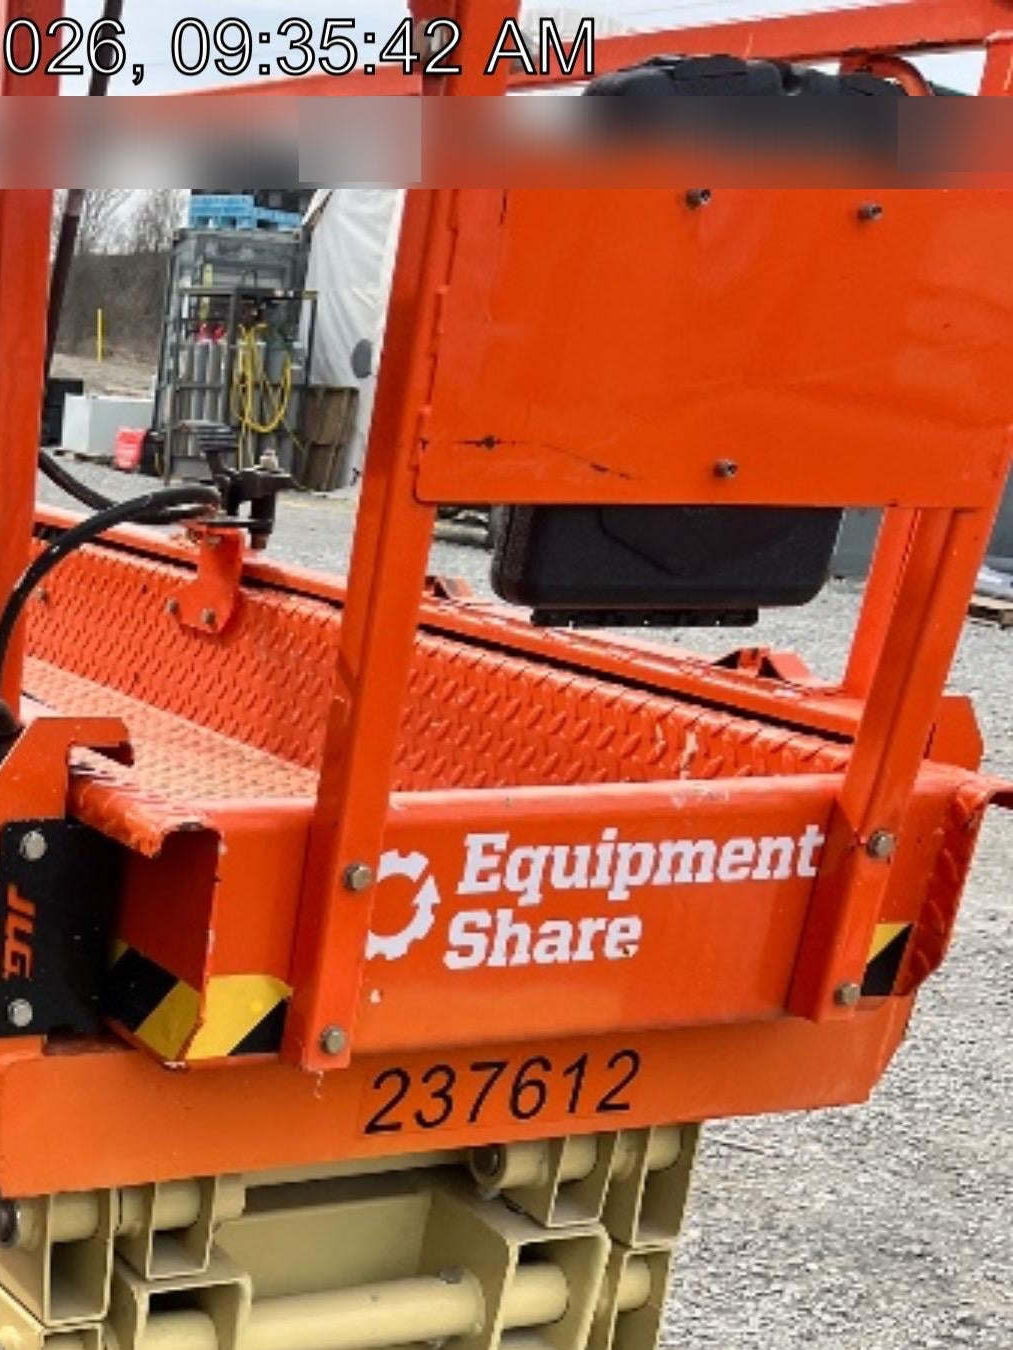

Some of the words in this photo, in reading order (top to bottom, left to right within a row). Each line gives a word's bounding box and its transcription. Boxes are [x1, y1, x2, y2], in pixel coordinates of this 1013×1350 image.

[456, 824, 825, 902] Equipment
[2, 884, 36, 980] JLG
[443, 908, 643, 970] Share
[364, 1049, 643, 1135] 237612
